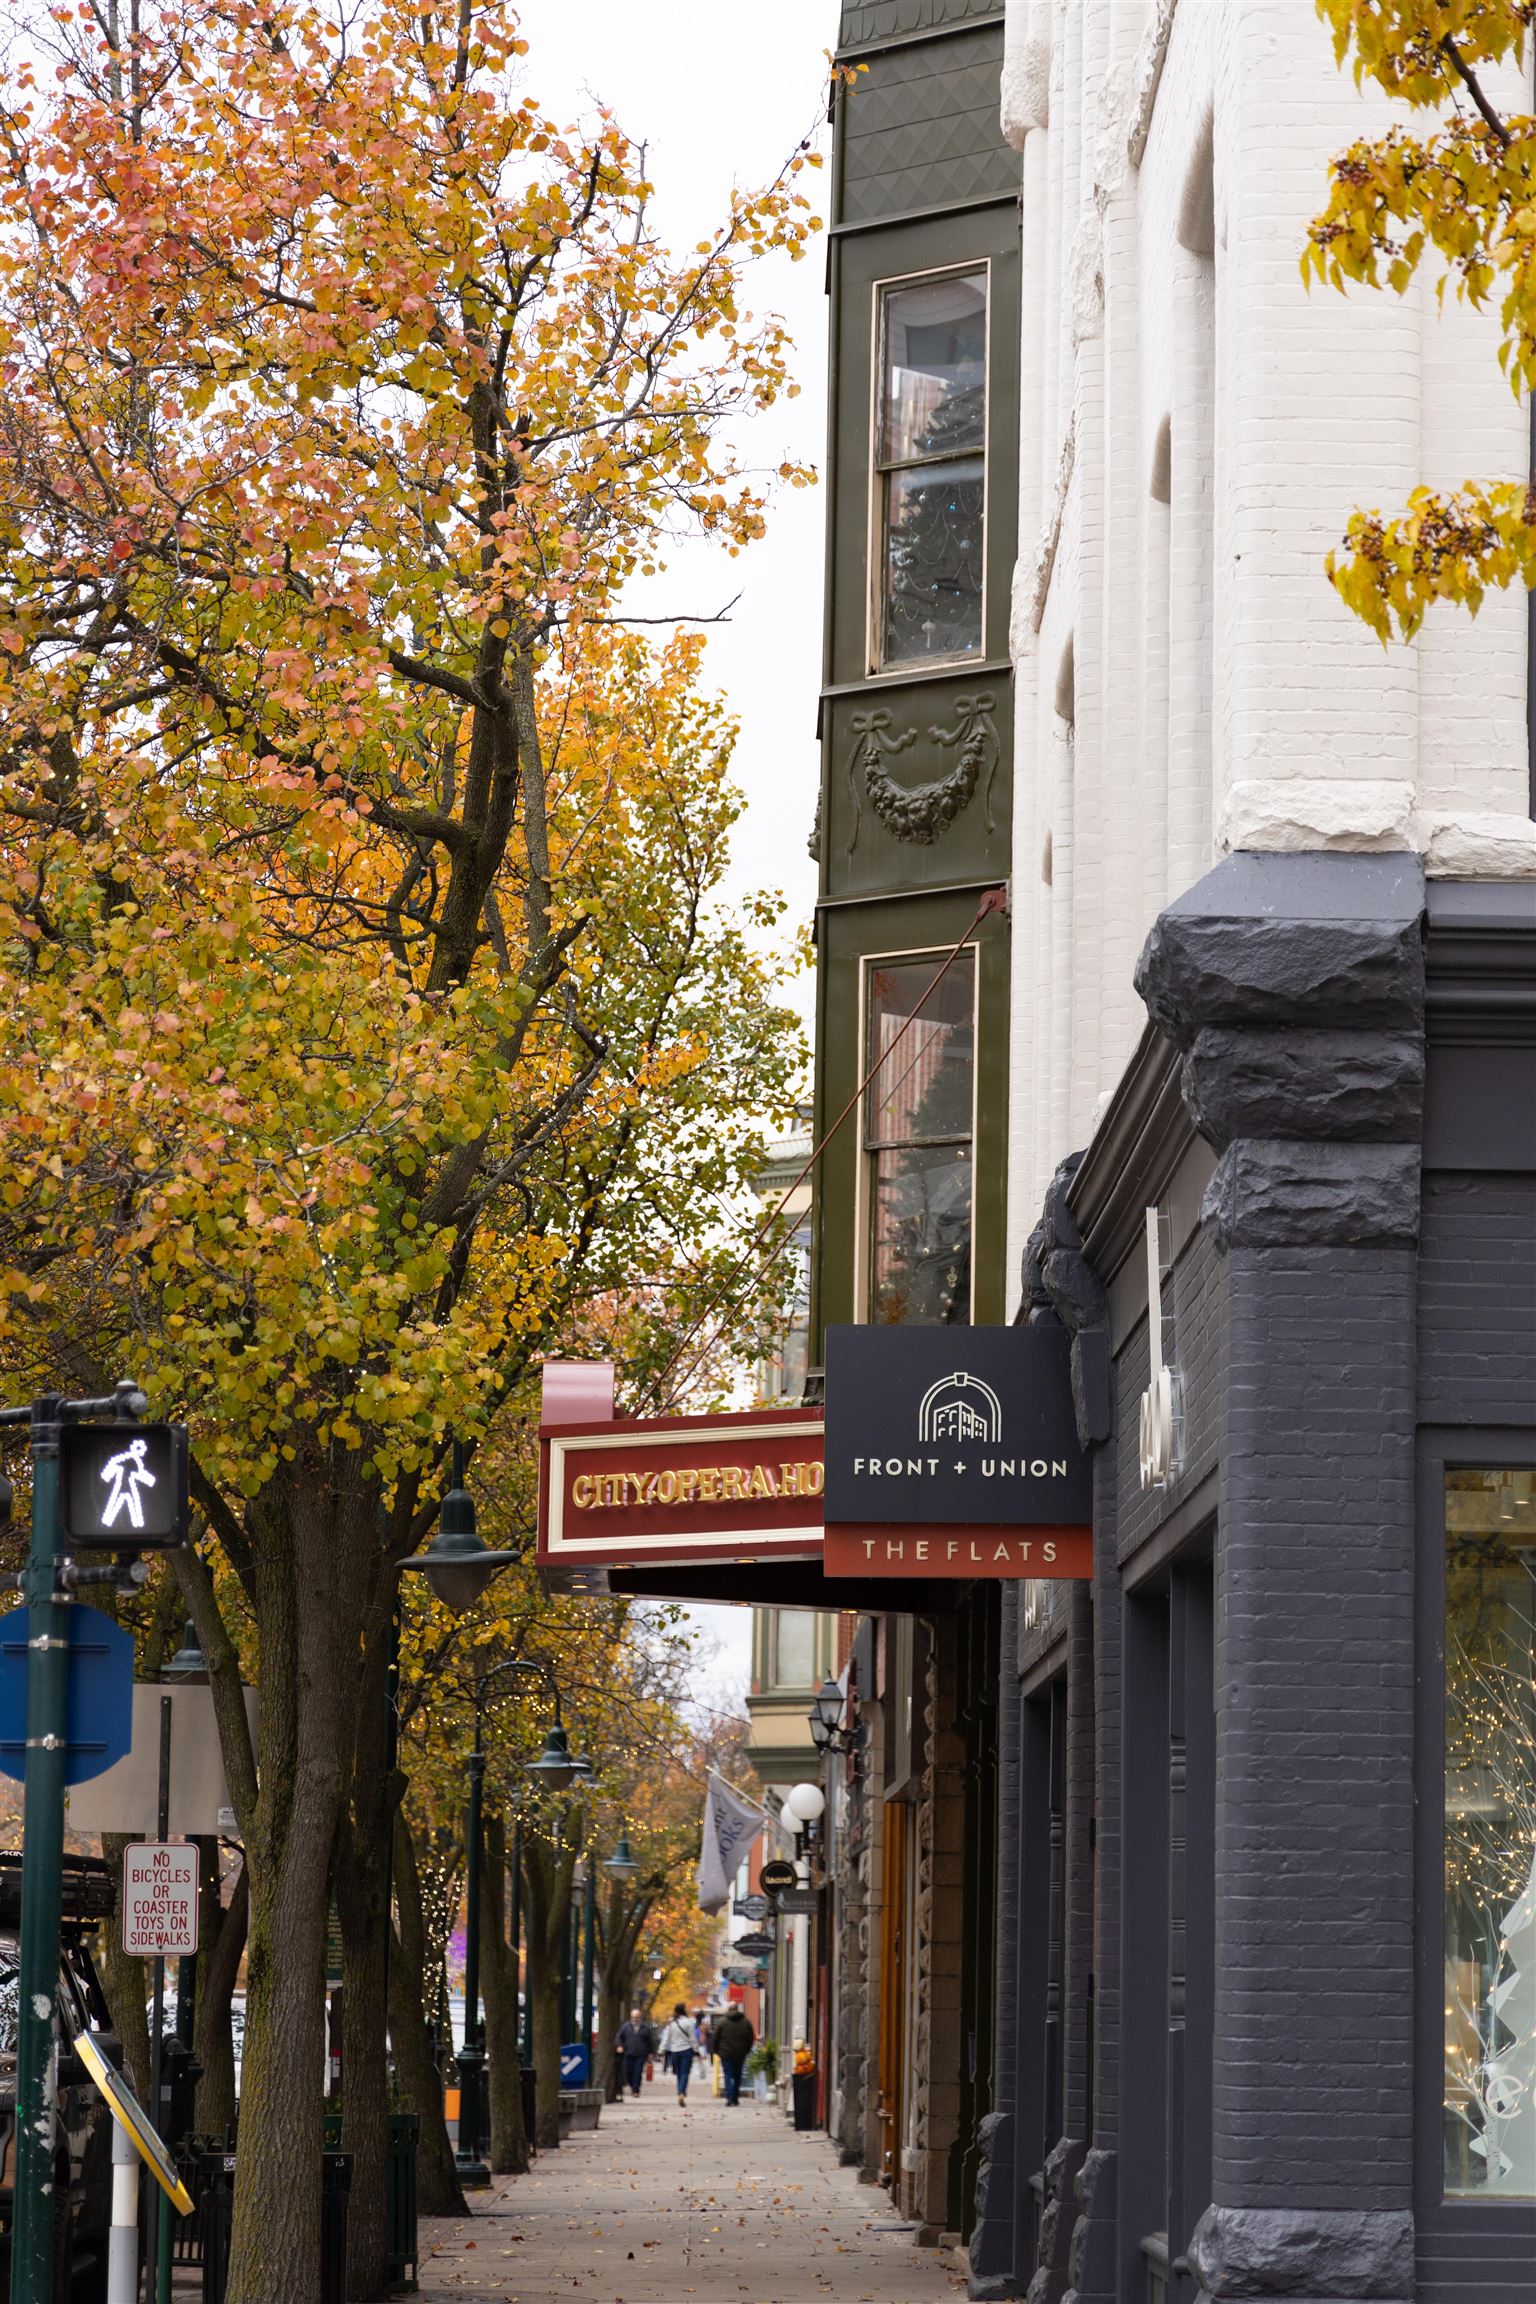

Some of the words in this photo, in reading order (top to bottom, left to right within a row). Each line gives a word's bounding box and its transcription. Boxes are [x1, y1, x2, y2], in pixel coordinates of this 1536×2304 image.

[854, 1458, 940, 1476] FRONT
[981, 1459, 1067, 1477] UNION
[657, 1465, 772, 1504] OPERA
[862, 1539, 929, 1561] THE
[947, 1541, 1057, 1562] FLATS
[153, 1853, 170, 1867] NO
[132, 1869, 191, 1883] BICYCLES
[153, 1885, 170, 1898] OR
[133, 1901, 188, 1914] COASTER
[135, 1916, 164, 1930] TOYS
[170, 1916, 187, 1930] ON
[130, 1932, 191, 1946] SIDEWALKS
